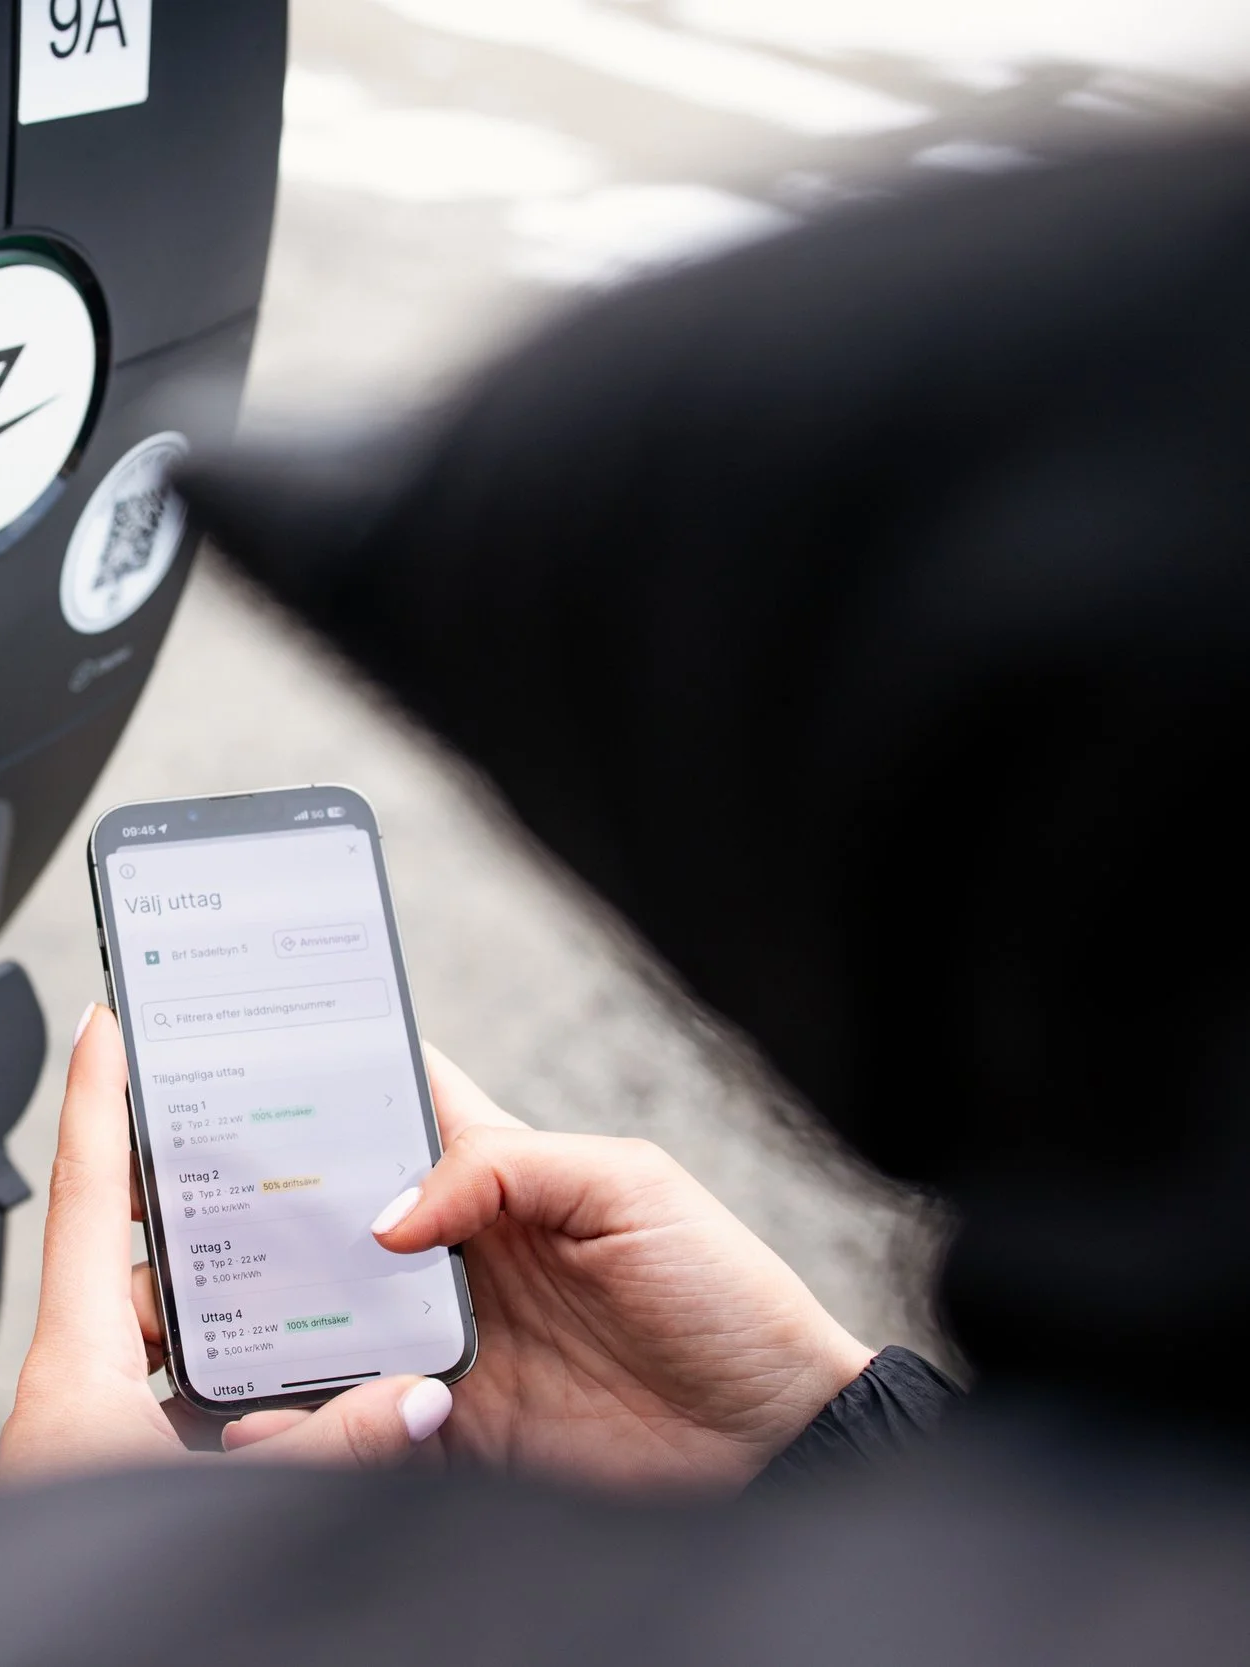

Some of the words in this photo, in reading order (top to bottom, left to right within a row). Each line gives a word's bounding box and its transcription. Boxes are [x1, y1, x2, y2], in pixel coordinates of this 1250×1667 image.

[49, 0, 128, 58] 9A
[122, 824, 155, 838] 09:45
[124, 893, 162, 916] Välj
[168, 891, 222, 911] uttag
[172, 950, 187, 961] Brf
[190, 946, 239, 959] Sadelbyn
[241, 944, 248, 954] 5
[300, 932, 360, 947] Anvisningar
[176, 1012, 213, 1025] Filtrera
[216, 1008, 240, 1020] efter
[244, 998, 336, 1018] laddningsnummer
[152, 1068, 214, 1085] Tillgängliga
[216, 1065, 245, 1079] uttag
[168, 1102, 198, 1115] Uttag
[201, 1101, 206, 1110] 1
[188, 1120, 203, 1130] Typ
[204, 1119, 210, 1127] 2
[218, 1116, 228, 1125] 22
[230, 1114, 243, 1123] kW
[251, 1111, 272, 1121] 100%
[274, 1106, 313, 1118] driftsäker
[190, 1135, 208, 1145] 5,00
[210, 1132, 238, 1143] kr/kWh
[179, 1171, 210, 1184] Uttag
[212, 1170, 219, 1180] 2
[199, 1190, 214, 1199] Typ
[216, 1189, 222, 1197] 2
[230, 1186, 239, 1195] 22
[241, 1184, 255, 1194] kW
[263, 1181, 281, 1191] 50%
[282, 1176, 321, 1189] driftsäker
[202, 1204, 220, 1215] 5,00
[222, 1201, 250, 1213] kr/kWh
[190, 1242, 221, 1255] Uttag
[223, 1241, 231, 1250] 3
[210, 1259, 226, 1269] Typ
[227, 1258, 233, 1266] 2
[241, 1255, 251, 1264] 22
[253, 1253, 267, 1263] kW
[212, 1273, 231, 1284] 5,00
[233, 1270, 262, 1281] kr/kWh
[201, 1311, 232, 1324] Uttag
[234, 1310, 242, 1319] 4
[222, 1329, 237, 1339] Typ
[239, 1328, 245, 1336] 2
[252, 1325, 262, 1334] 22
[264, 1324, 278, 1333] kW
[286, 1320, 308, 1330] 100%
[310, 1315, 349, 1327] driftsäker
[224, 1345, 243, 1356] 5,00
[245, 1342, 274, 1354] kr/kWh
[213, 1384, 244, 1397] Uttag
[246, 1383, 254, 1392] 5
